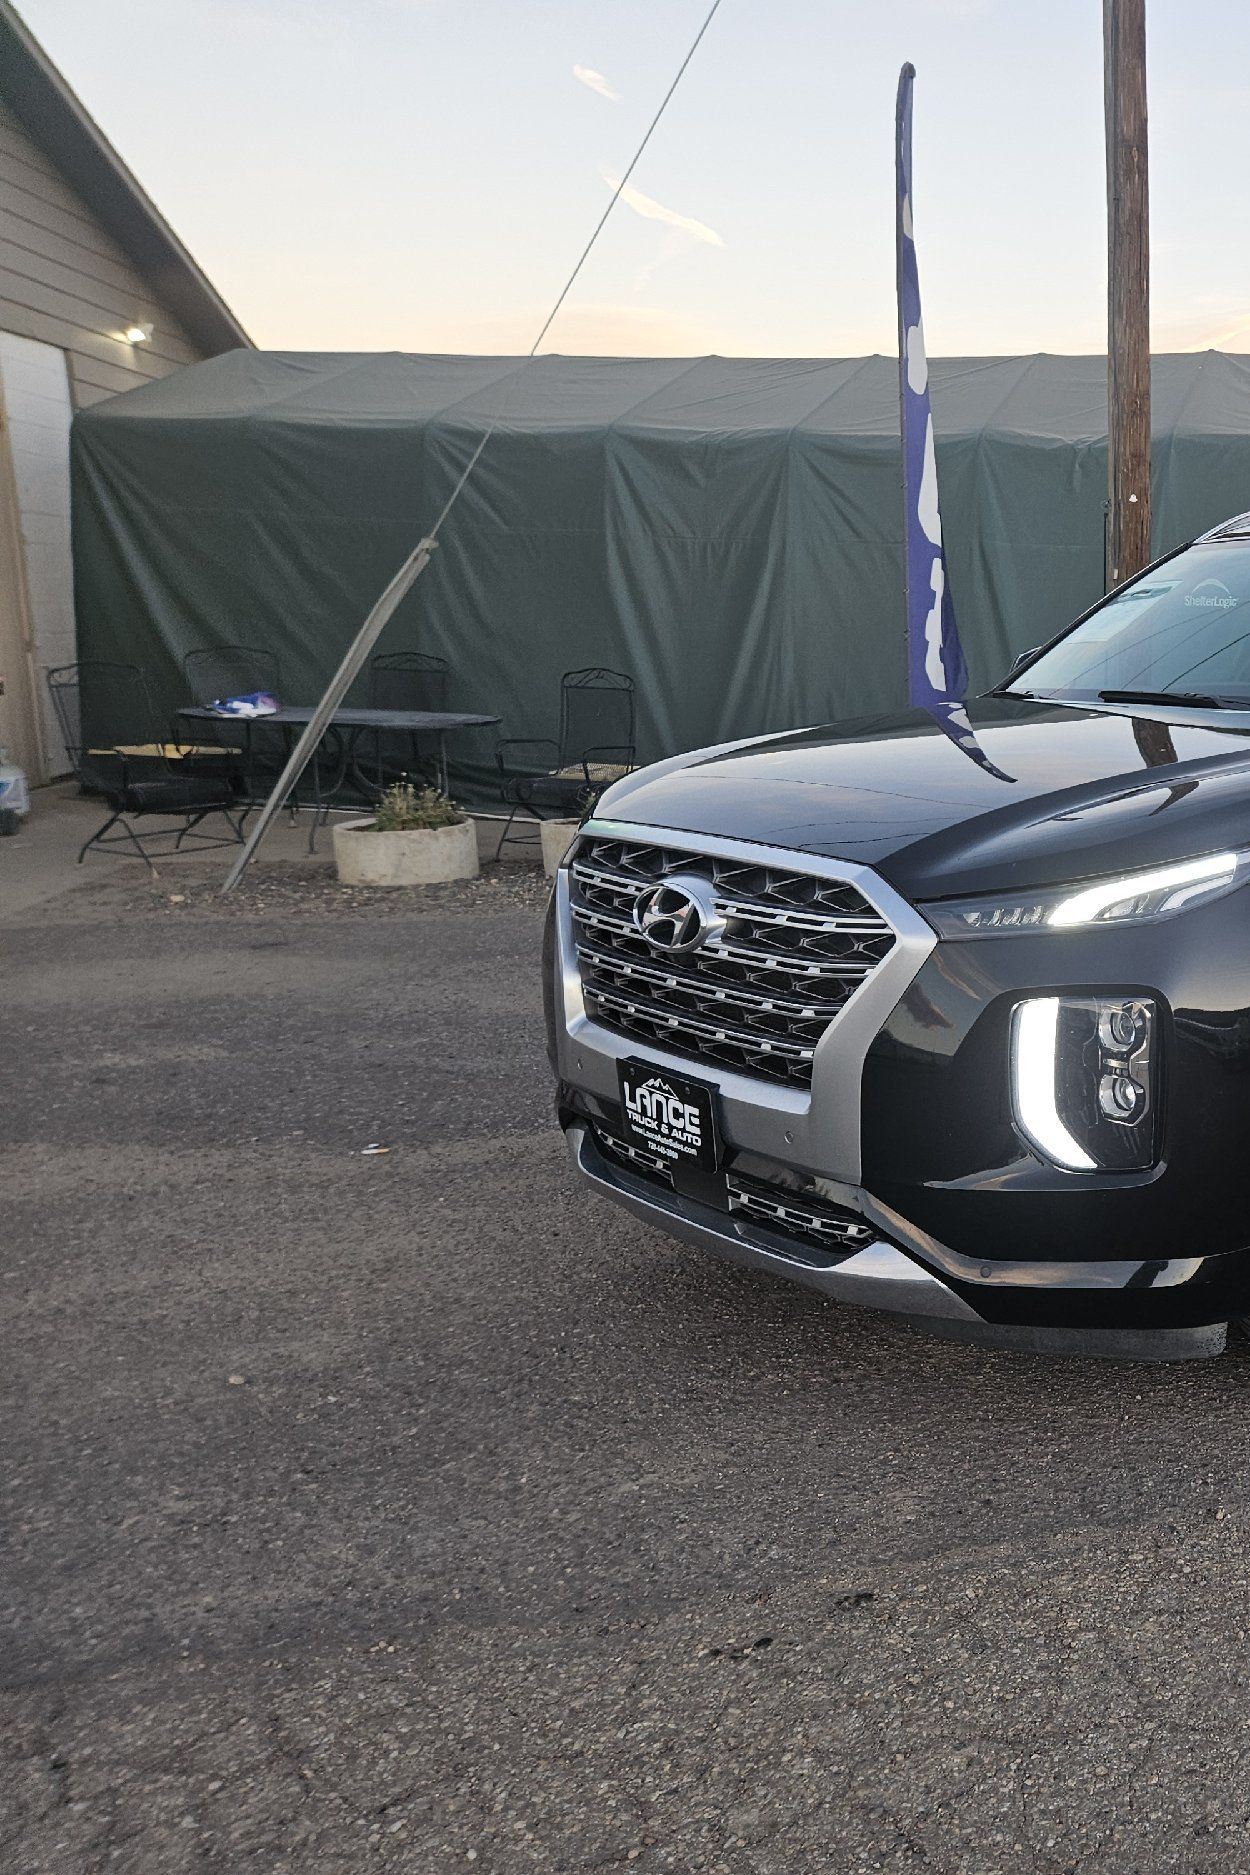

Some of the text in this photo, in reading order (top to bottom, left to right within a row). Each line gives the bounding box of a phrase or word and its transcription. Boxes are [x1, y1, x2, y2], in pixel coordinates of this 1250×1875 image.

[1184, 595, 1238, 609] ShelterLogic
[624, 1081, 701, 1135] LANCE
[627, 1109, 702, 1147] TRUCK & AUTO
